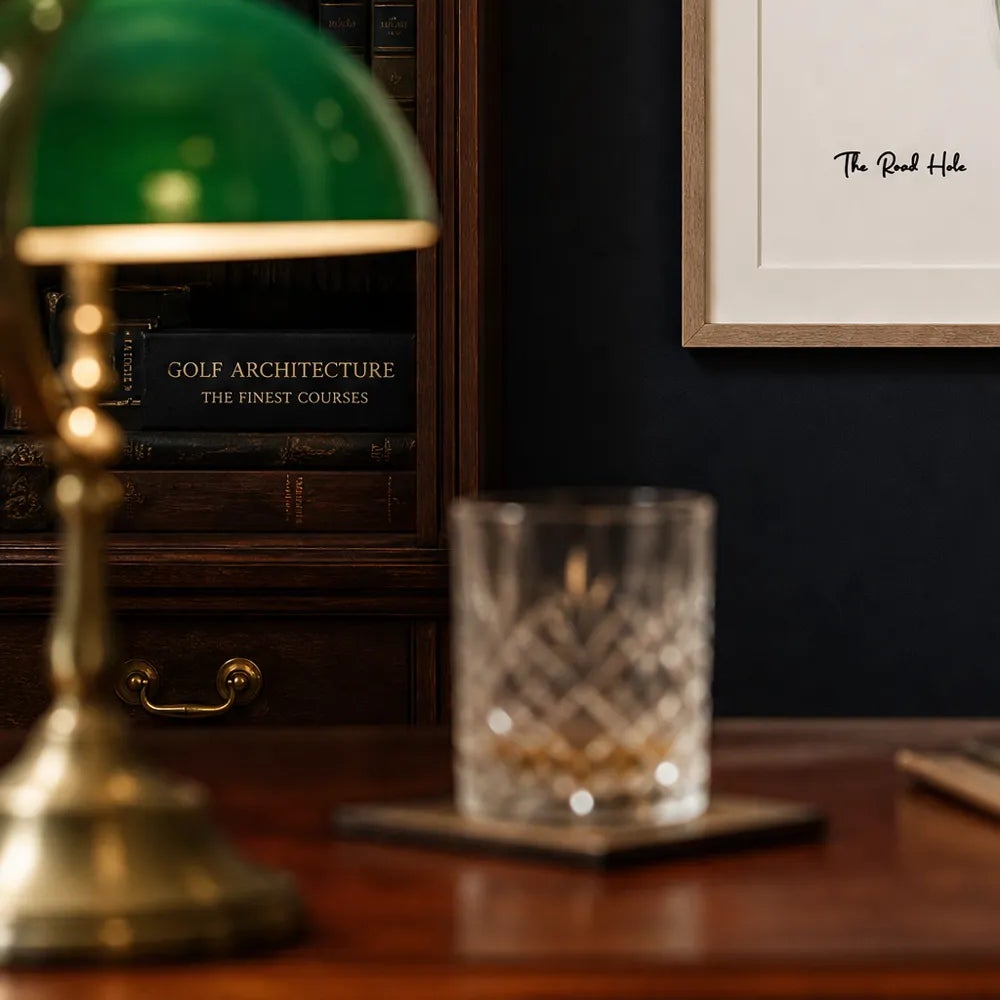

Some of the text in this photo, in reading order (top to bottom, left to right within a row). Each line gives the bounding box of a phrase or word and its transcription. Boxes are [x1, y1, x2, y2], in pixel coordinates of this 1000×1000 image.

[833, 150, 967, 179] The Road Hole
[167, 361, 395, 379] GOLF ARCHITECTURE
[201, 391, 369, 404] THE FINEST COURSES
